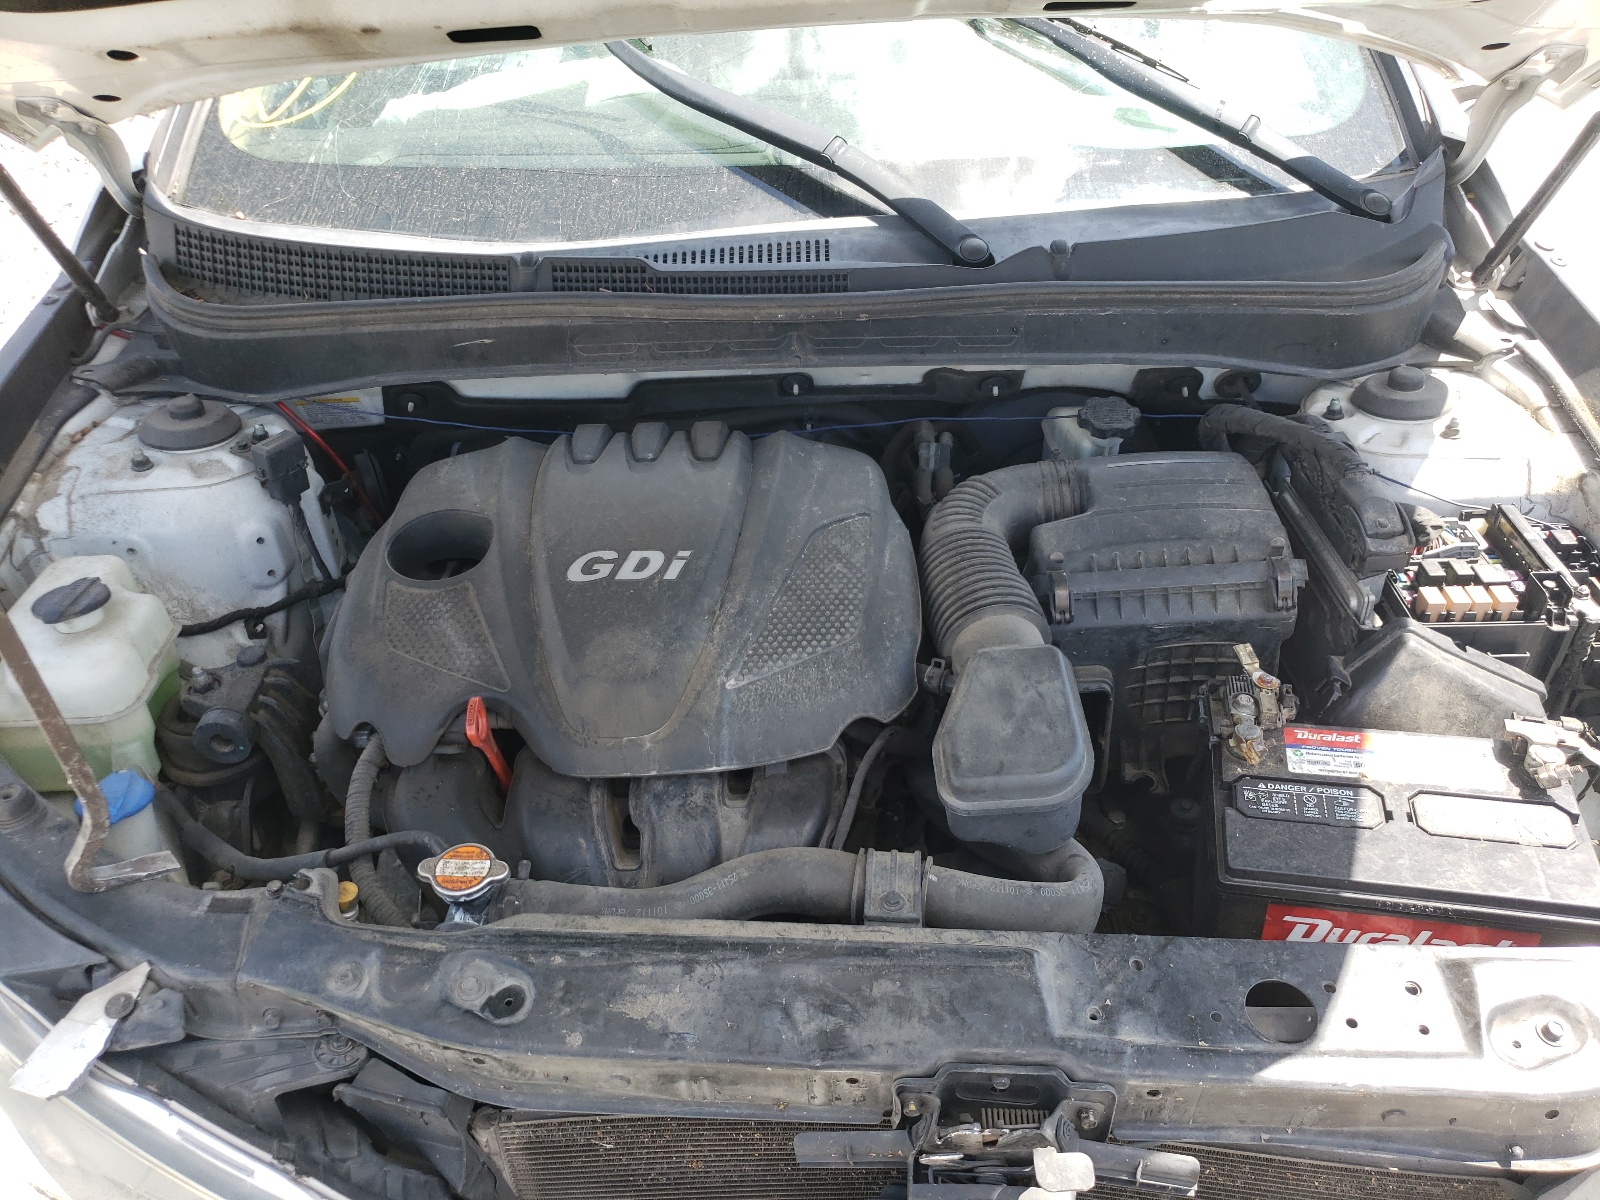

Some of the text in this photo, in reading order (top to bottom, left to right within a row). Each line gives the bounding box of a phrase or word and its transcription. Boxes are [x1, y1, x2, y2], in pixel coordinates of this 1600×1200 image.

[566, 550, 694, 582] GDi
[1294, 730, 1361, 743] Duralast
[1267, 783, 1307, 792] DANGER
[1317, 787, 1353, 797] POISON
[1282, 916, 1515, 947] Dural
